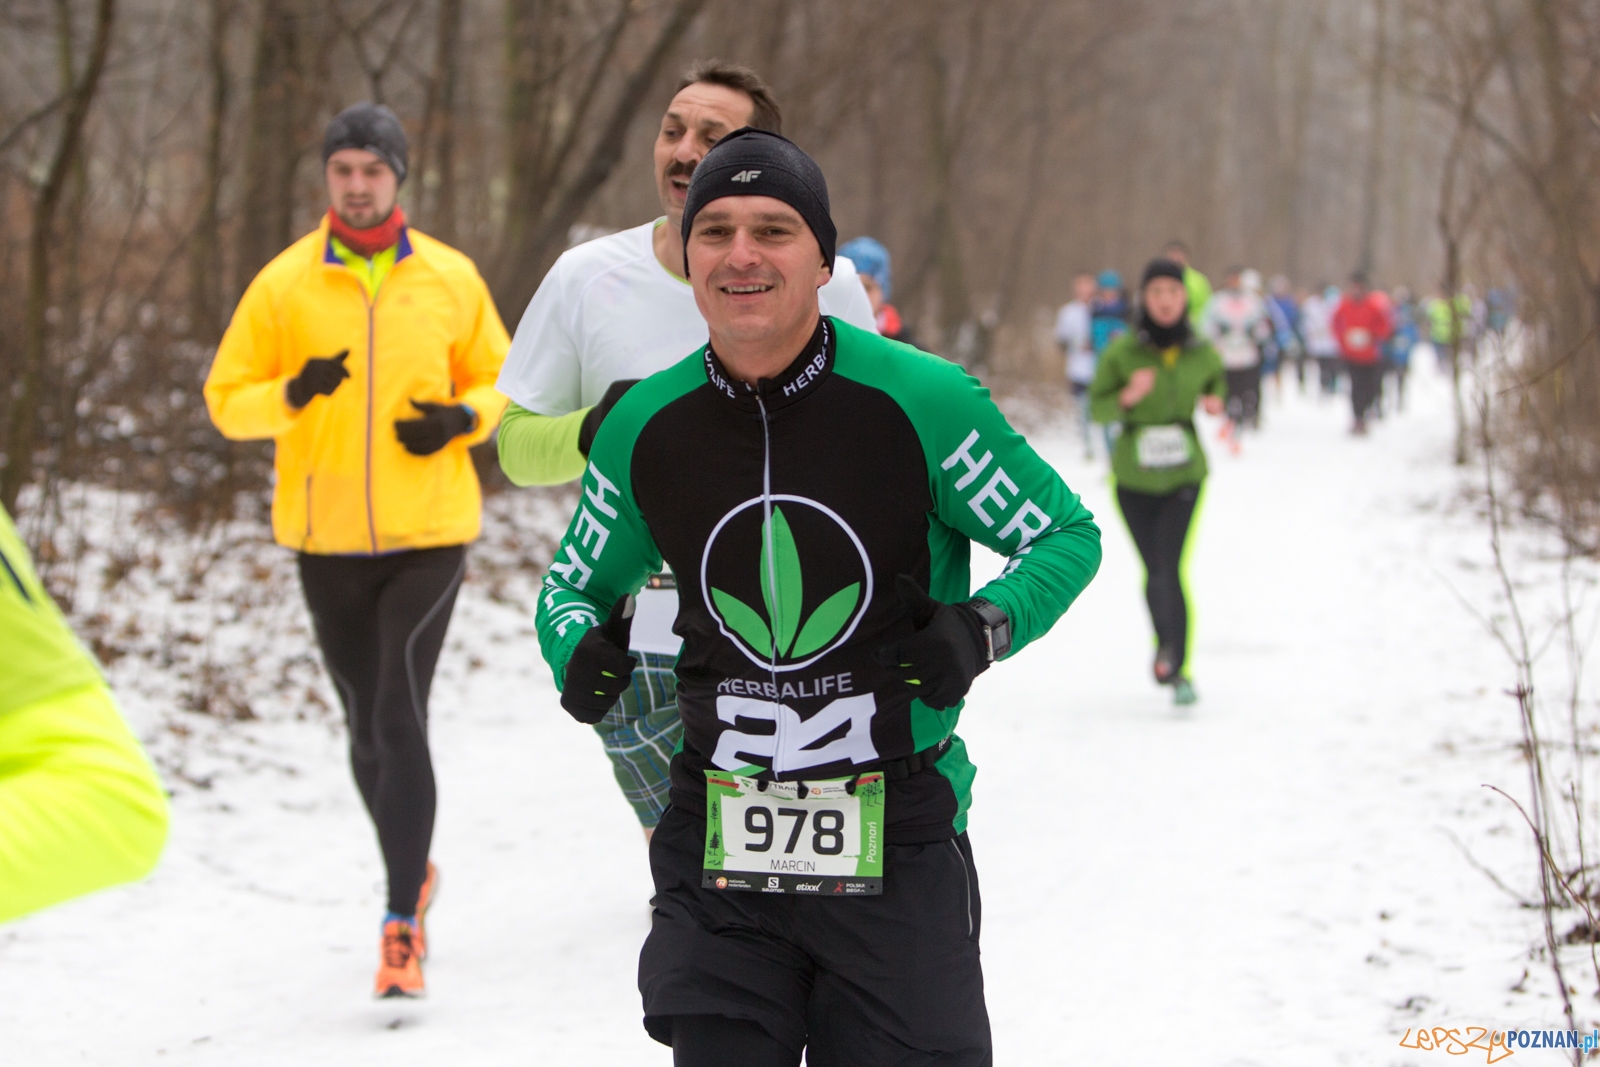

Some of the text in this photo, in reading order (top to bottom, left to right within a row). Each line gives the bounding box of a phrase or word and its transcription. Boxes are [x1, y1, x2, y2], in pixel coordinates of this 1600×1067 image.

[731, 170, 762, 183] 4F
[717, 672, 853, 699] HERBALIFE
[711, 692, 880, 772] 24
[744, 805, 845, 856] 978
[866, 821, 877, 864] Poznań
[770, 858, 816, 873] MARCIN
